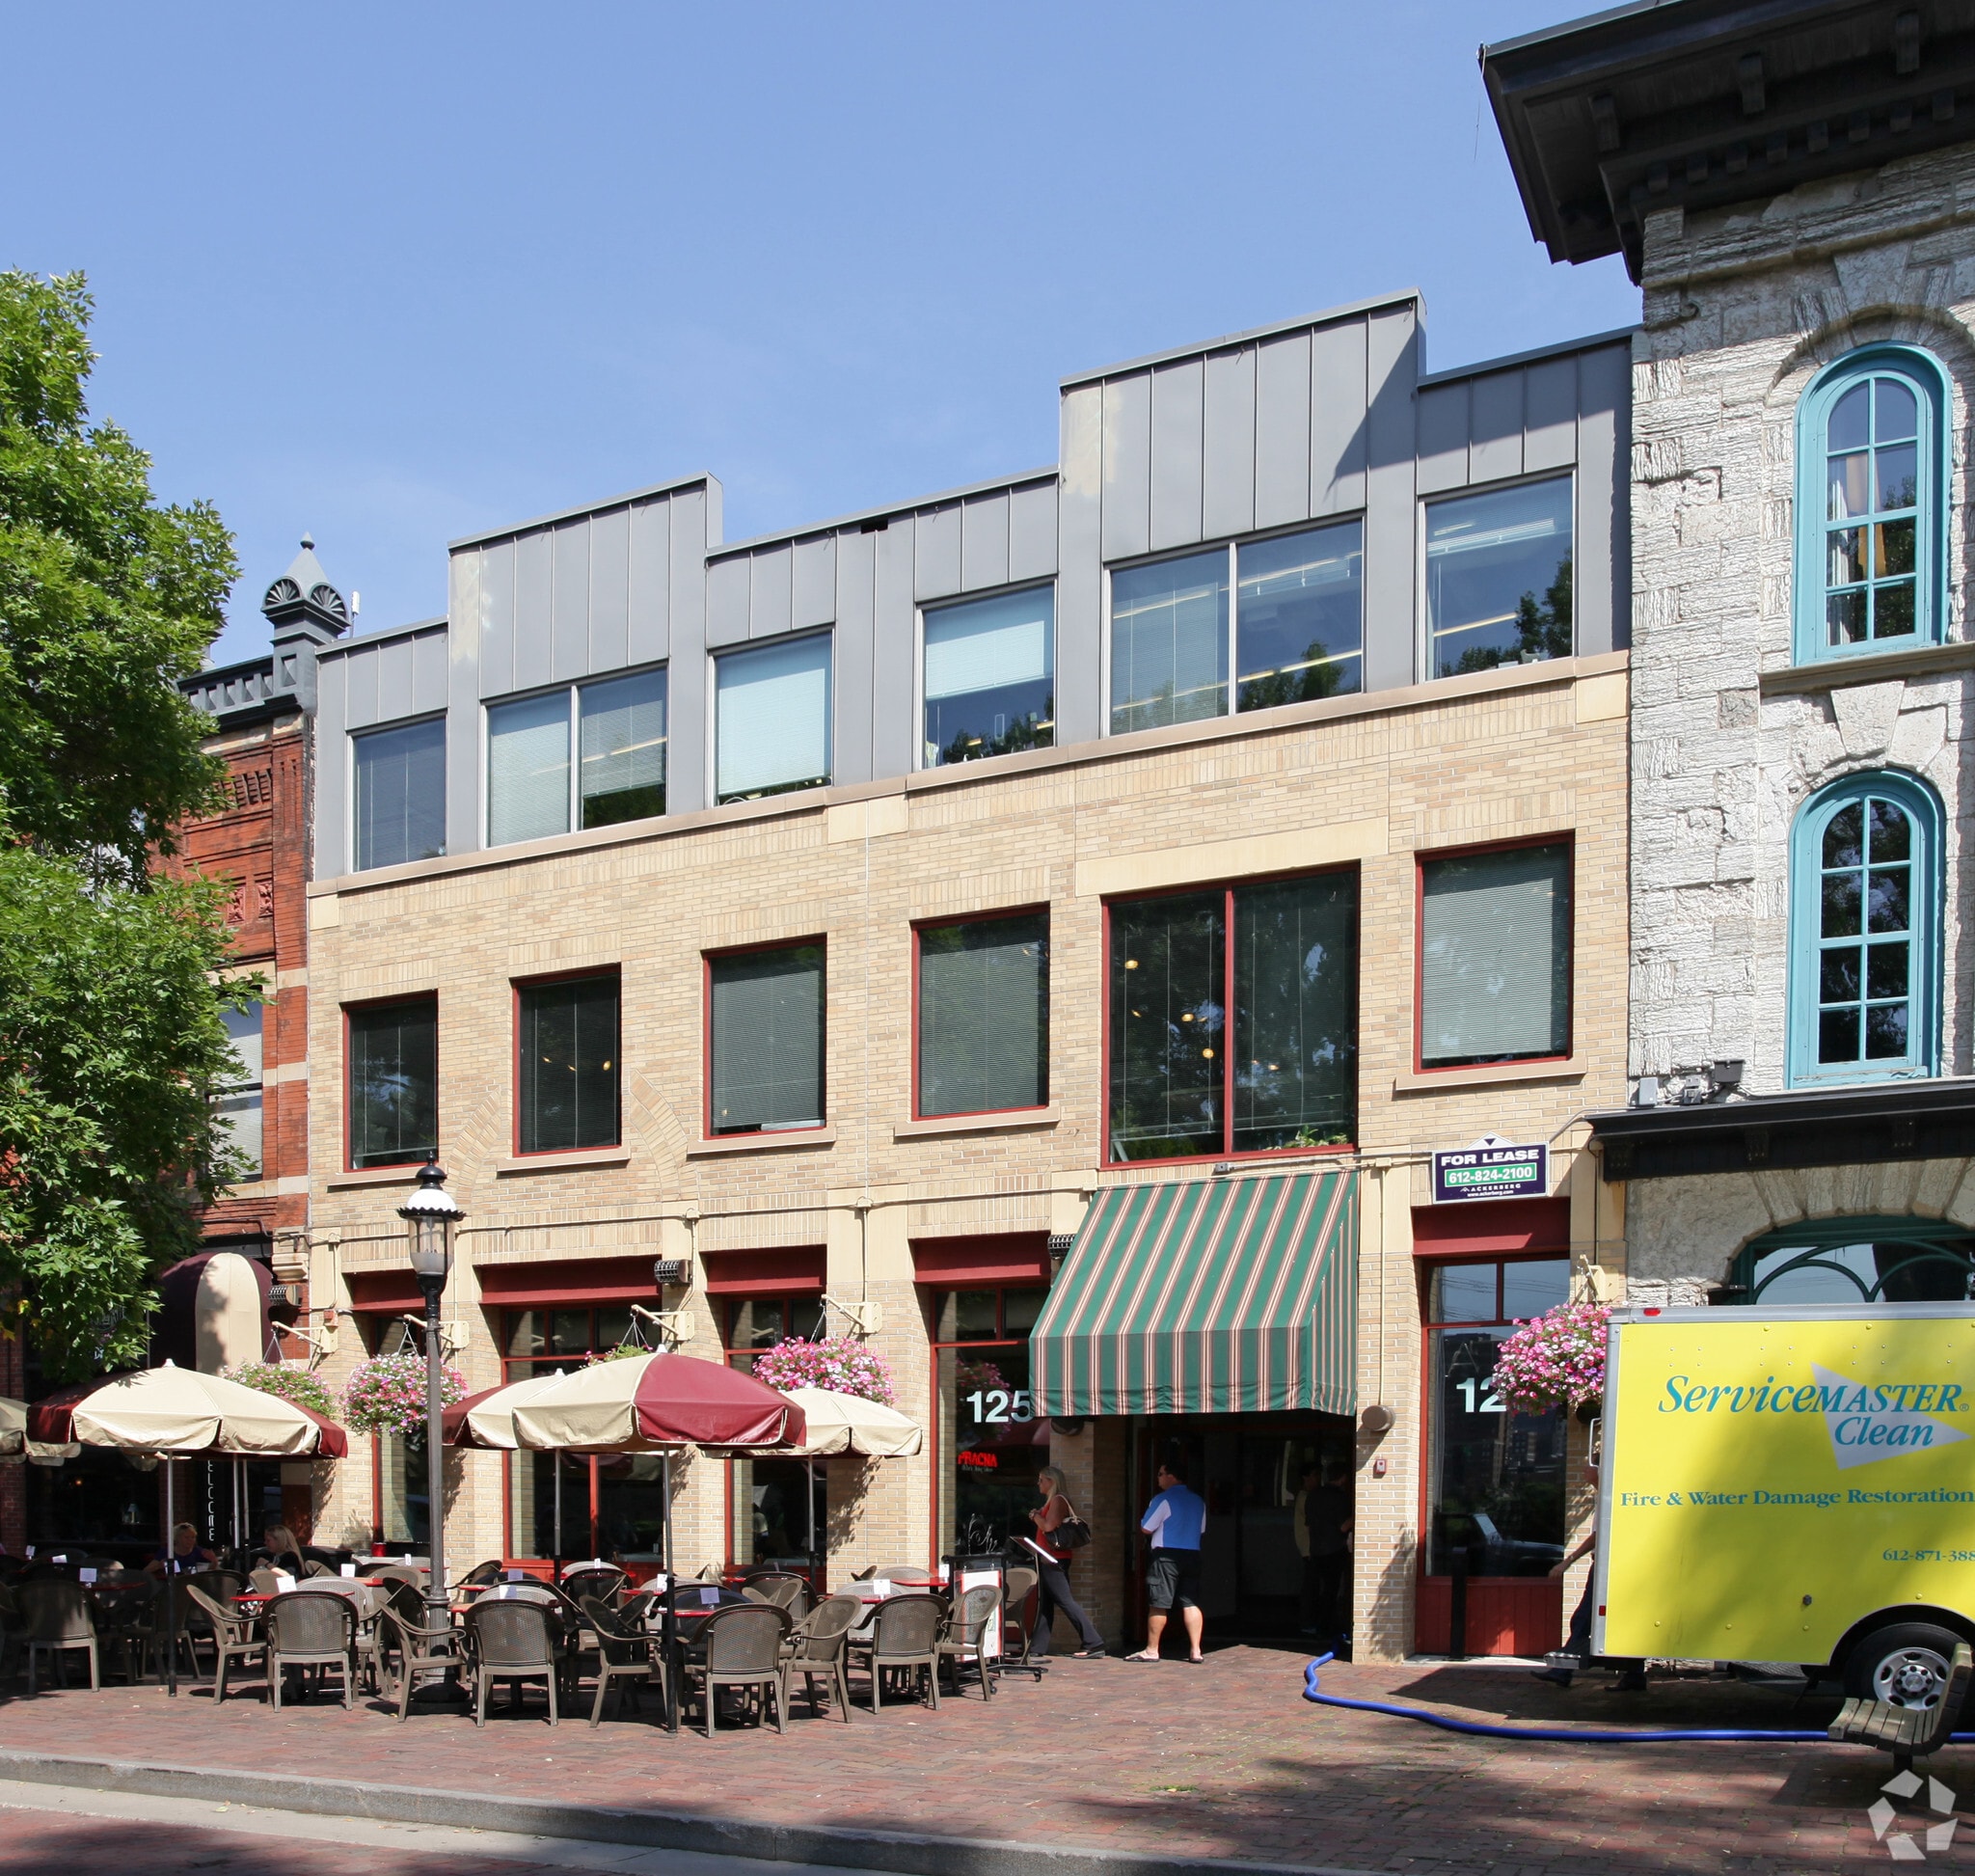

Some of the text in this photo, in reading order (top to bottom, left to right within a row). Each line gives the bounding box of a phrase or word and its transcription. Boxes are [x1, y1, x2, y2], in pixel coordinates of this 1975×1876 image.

[1441, 1149, 1540, 1167] FOR LEASE
[1448, 1166, 1532, 1183] 612-824-2100
[1471, 1183, 1521, 1192] ACKERBERG
[966, 1390, 1034, 1423] 125
[1834, 1416, 1934, 1447] Clean
[958, 1451, 998, 1467] PRACNA
[1620, 1487, 1975, 1509] Fire & Water Damage Restoration
